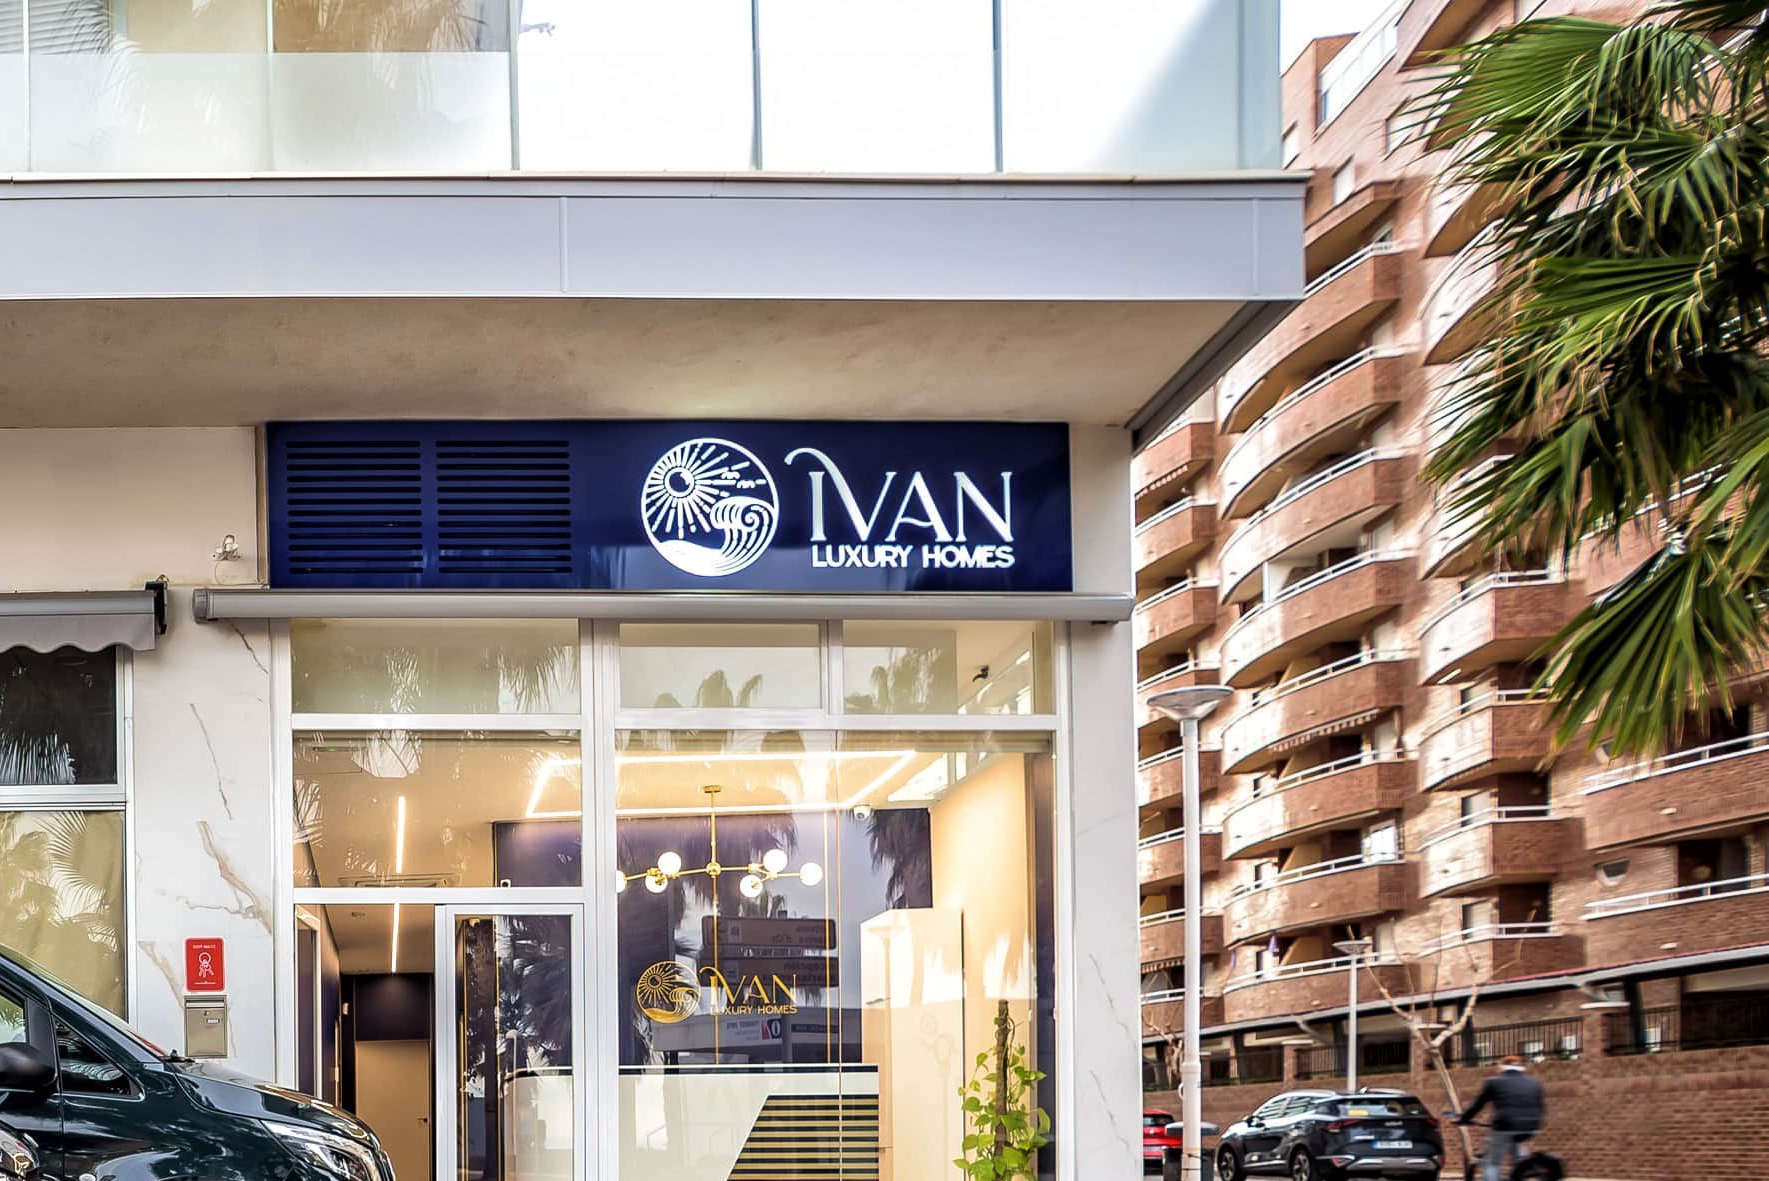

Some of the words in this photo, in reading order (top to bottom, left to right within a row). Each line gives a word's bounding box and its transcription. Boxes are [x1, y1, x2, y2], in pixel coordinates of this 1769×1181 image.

[784, 447, 1014, 542] IVAN
[812, 544, 912, 568] LUXURY
[922, 544, 1016, 568] HOMES
[699, 966, 798, 1004] IVAN
[757, 1004, 798, 1015] HOMES
